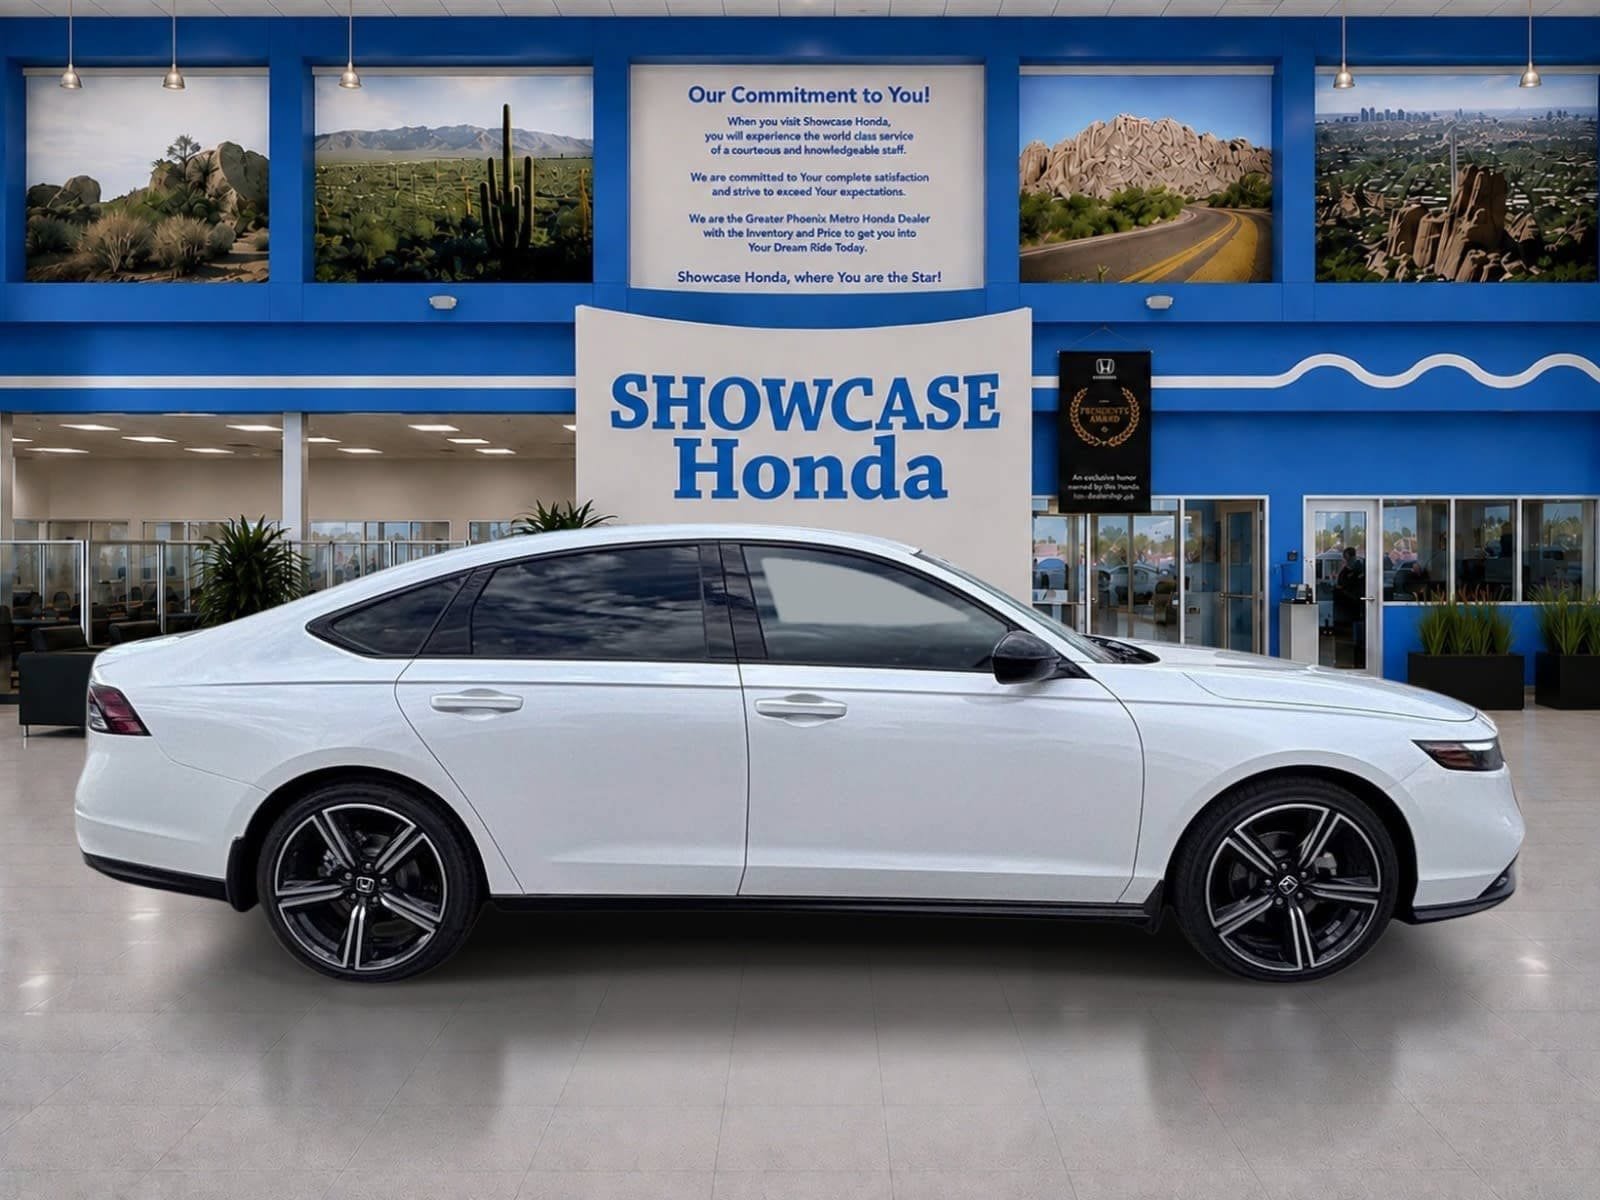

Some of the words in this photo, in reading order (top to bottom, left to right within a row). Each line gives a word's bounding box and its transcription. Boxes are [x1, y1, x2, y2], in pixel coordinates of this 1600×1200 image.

[688, 86, 726, 103] Our
[731, 86, 857, 103] Commitment
[862, 88, 883, 103] to
[887, 86, 929, 103] You!
[727, 116, 756, 126] When
[758, 118, 777, 128] you
[779, 116, 801, 126] visit
[802, 116, 853, 126] Showcase
[855, 116, 891, 127] Honda,
[704, 132, 723, 143] you
[725, 130, 743, 140] will
[745, 131, 801, 143] experience
[803, 130, 820, 140] the
[822, 130, 851, 141] world
[853, 130, 877, 141] class
[878, 130, 913, 141] service
[710, 144, 721, 154] of
[731, 146, 781, 155] courteous
[782, 144, 802, 155] and
[881, 144, 906, 154] staff.
[690, 172, 707, 182] We
[709, 174, 726, 182] are
[728, 171, 784, 182] committed
[786, 173, 797, 182] to
[799, 172, 822, 182] Your
[824, 173, 872, 184] complete
[874, 171, 929, 182] satisfaction
[711, 185, 731, 196] and
[732, 186, 760, 196] strive
[762, 187, 774, 196] to
[776, 186, 812, 196] exceed
[814, 186, 838, 196] Your
[839, 187, 905, 199] expectations.
[688, 213, 706, 223] We
[707, 215, 724, 223] are
[726, 213, 743, 223] the
[744, 213, 784, 223] Greater
[786, 213, 826, 223] Phoenix
[829, 213, 860, 223] Metro
[862, 213, 895, 223] Honda
[897, 213, 930, 223] Dealer
[702, 227, 725, 237] with
[727, 227, 744, 237] the
[745, 228, 794, 240] Inventory
[795, 227, 814, 238] and
[816, 227, 842, 237] Price
[843, 229, 855, 237] to
[856, 229, 875, 240] get
[876, 230, 895, 240] you
[897, 228, 916, 237] into
[747, 242, 771, 252] Your
[773, 242, 807, 252] Dream
[809, 242, 832, 252] Ride
[834, 243, 867, 255] Today.
[677, 271, 741, 283] Showcase
[744, 271, 790, 284] Honda,
[793, 271, 834, 283] where
[837, 272, 860, 283] You
[863, 274, 884, 283] are
[886, 271, 908, 283] the
[911, 272, 941, 283] Star!
[611, 373, 1000, 431] SHOWCASE
[674, 434, 948, 500] Honda
